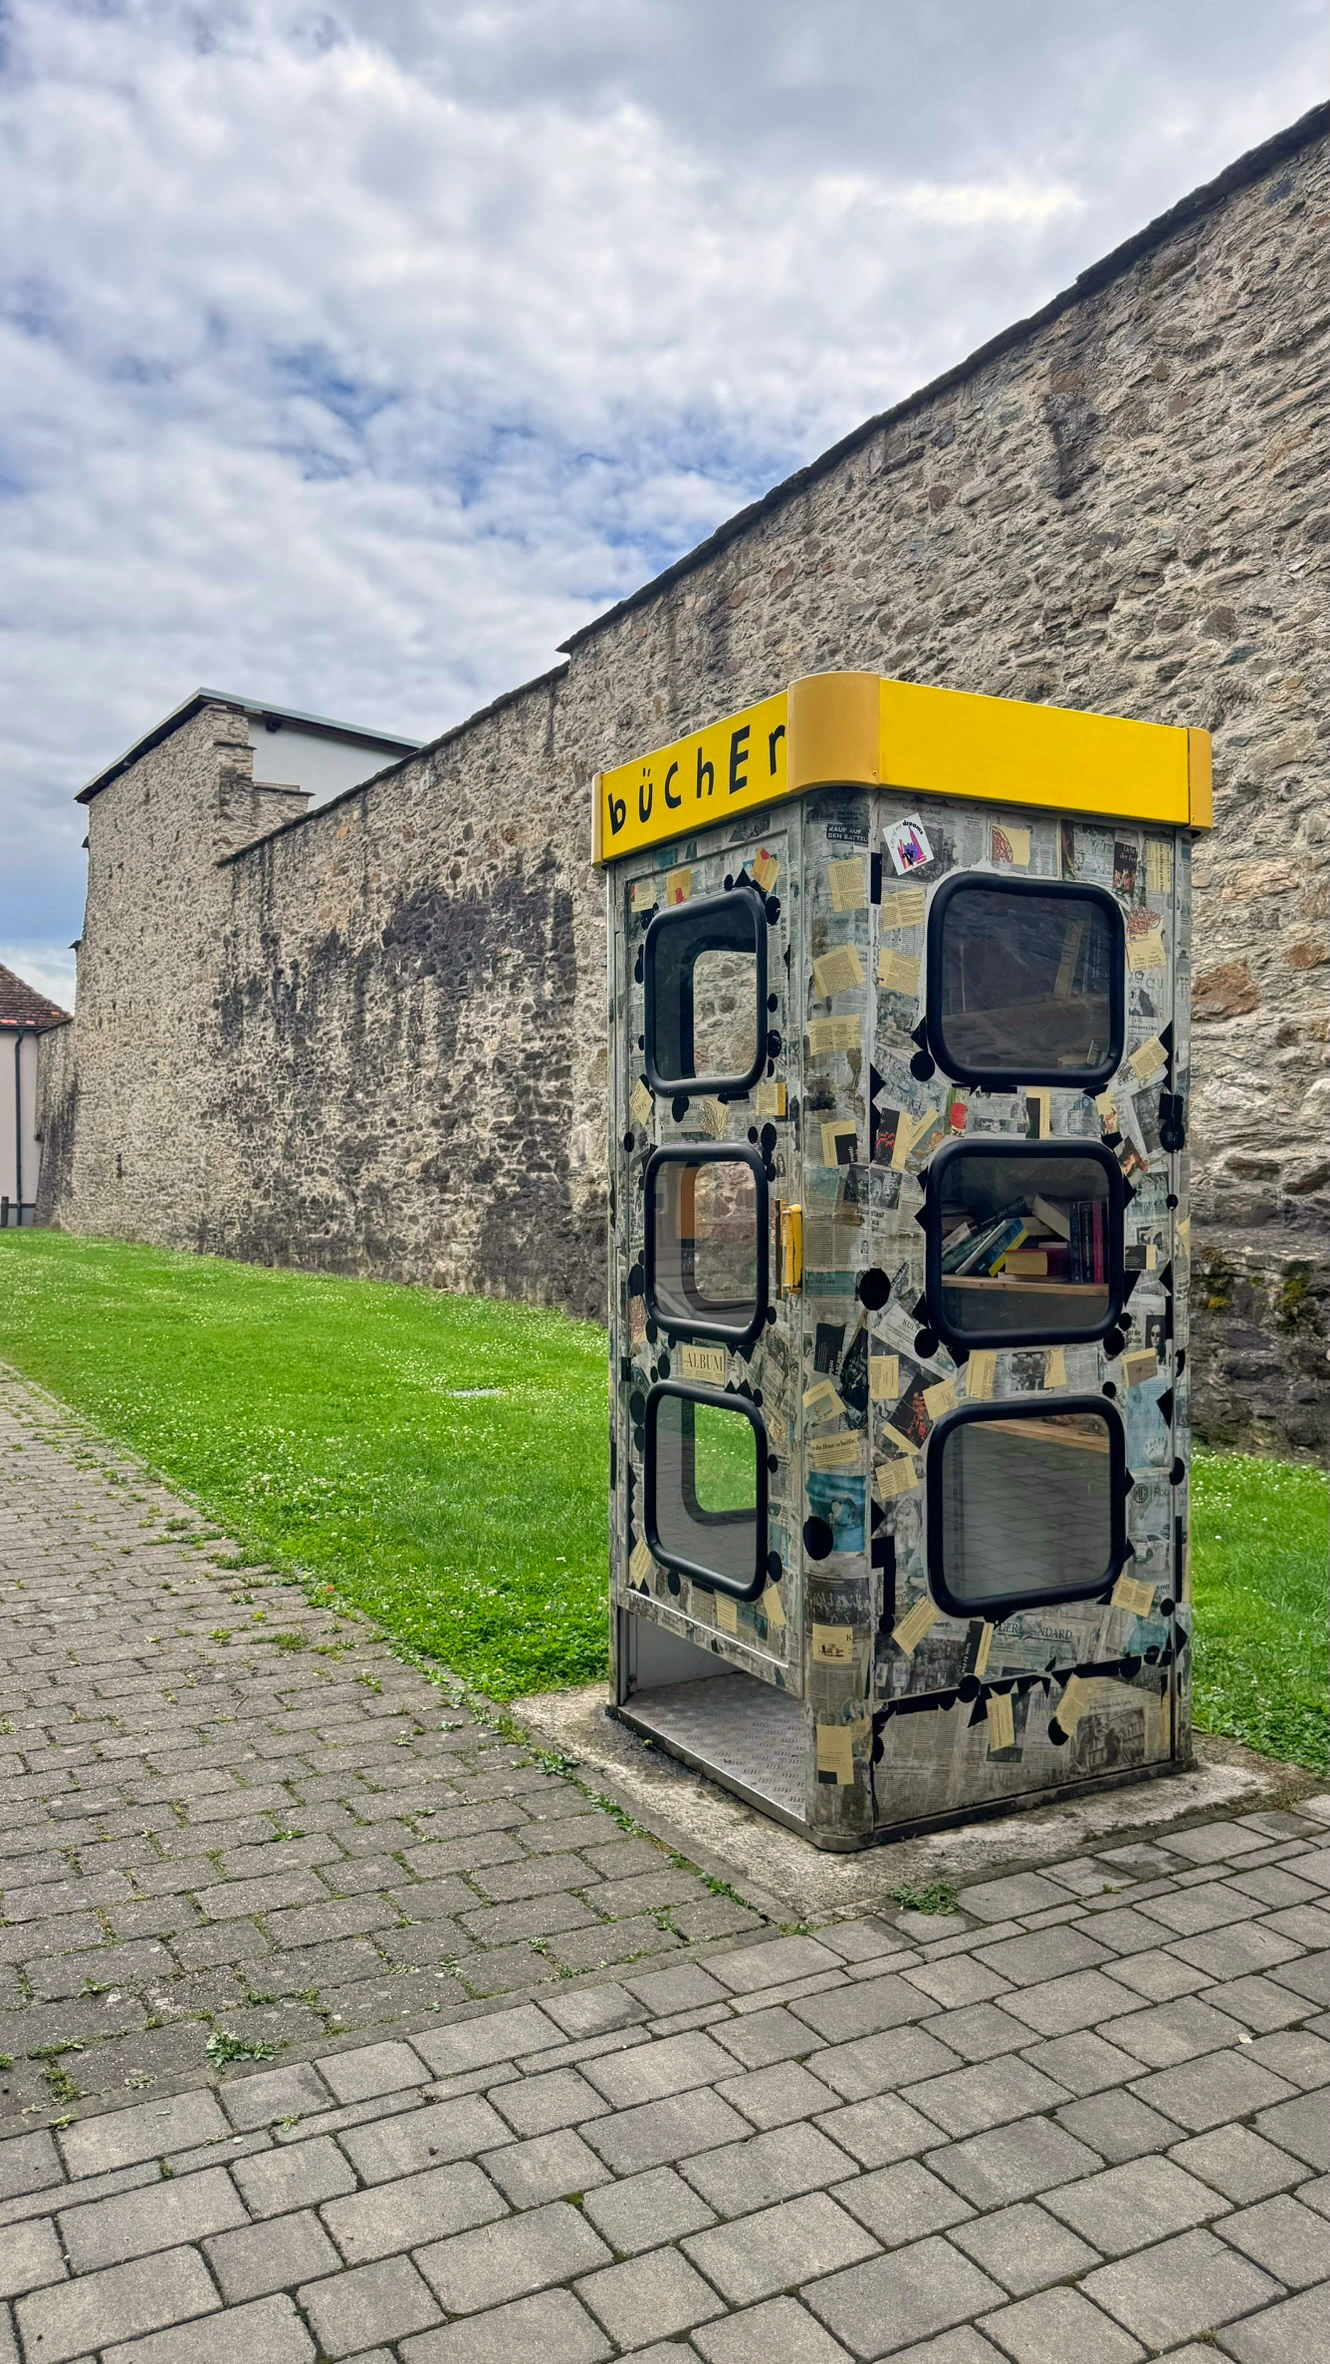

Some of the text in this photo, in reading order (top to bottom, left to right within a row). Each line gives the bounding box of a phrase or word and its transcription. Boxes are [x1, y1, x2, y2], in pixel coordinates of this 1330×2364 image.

[902, 820, 924, 835] dreams
[686, 1352, 723, 1372] ALBUM
[998, 1621, 1019, 1634] DER
